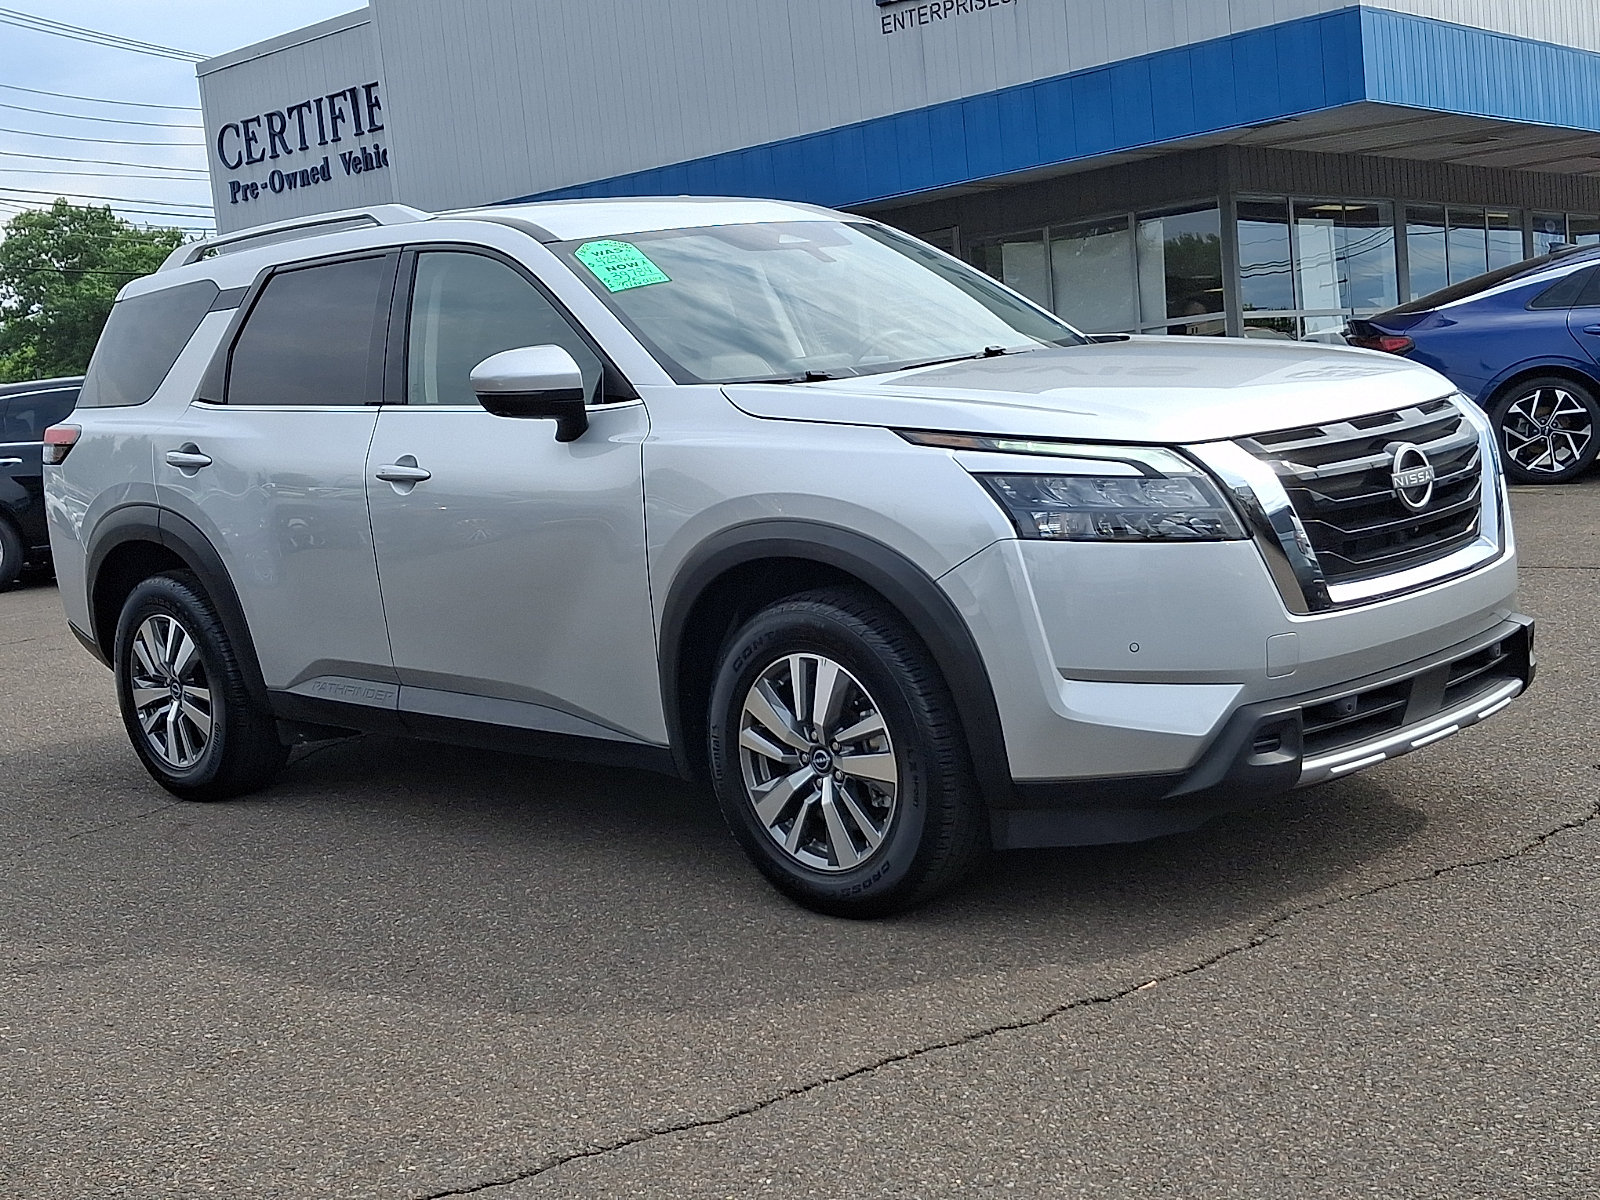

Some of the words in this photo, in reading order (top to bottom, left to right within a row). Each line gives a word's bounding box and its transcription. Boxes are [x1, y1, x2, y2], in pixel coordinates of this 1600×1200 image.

[217, 81, 385, 170] CERTIFIE
[228, 156, 332, 204] Pre-Owned
[590, 248, 624, 257] WAS
[604, 261, 639, 272] NOW
[1393, 468, 1435, 488] NISSAN
[311, 680, 395, 701] PATHFINDER
